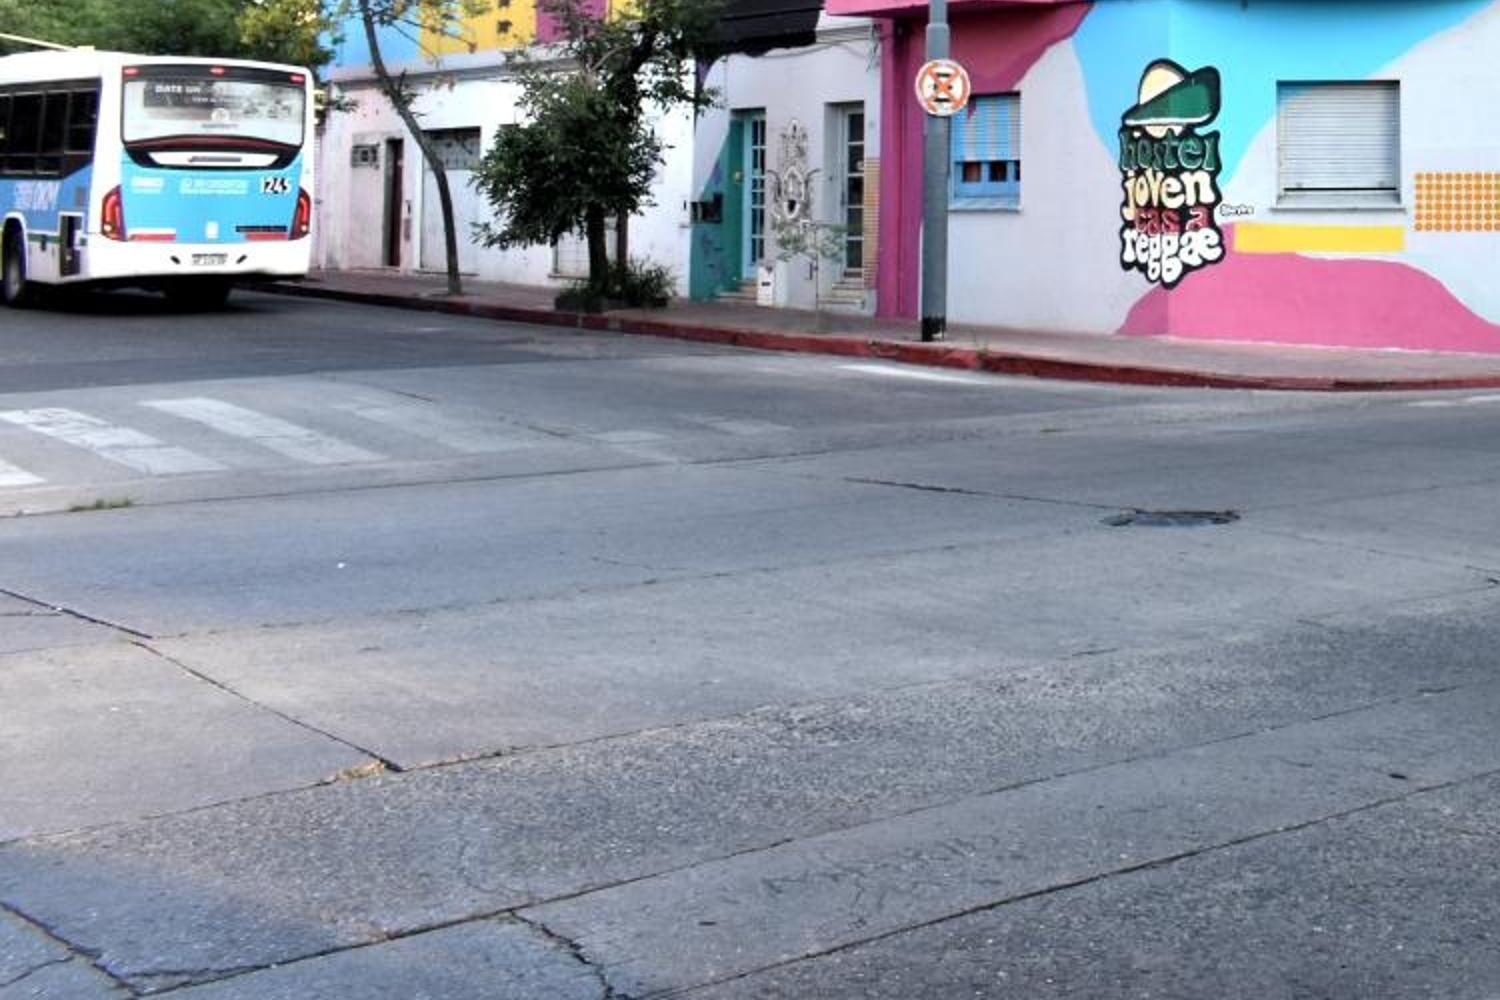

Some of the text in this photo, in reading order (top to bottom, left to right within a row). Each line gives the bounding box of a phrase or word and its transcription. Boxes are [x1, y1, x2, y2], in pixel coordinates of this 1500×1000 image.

[1120, 127, 1219, 171] hostel
[1122, 168, 1216, 220] joven
[1123, 226, 1223, 283] reggae
